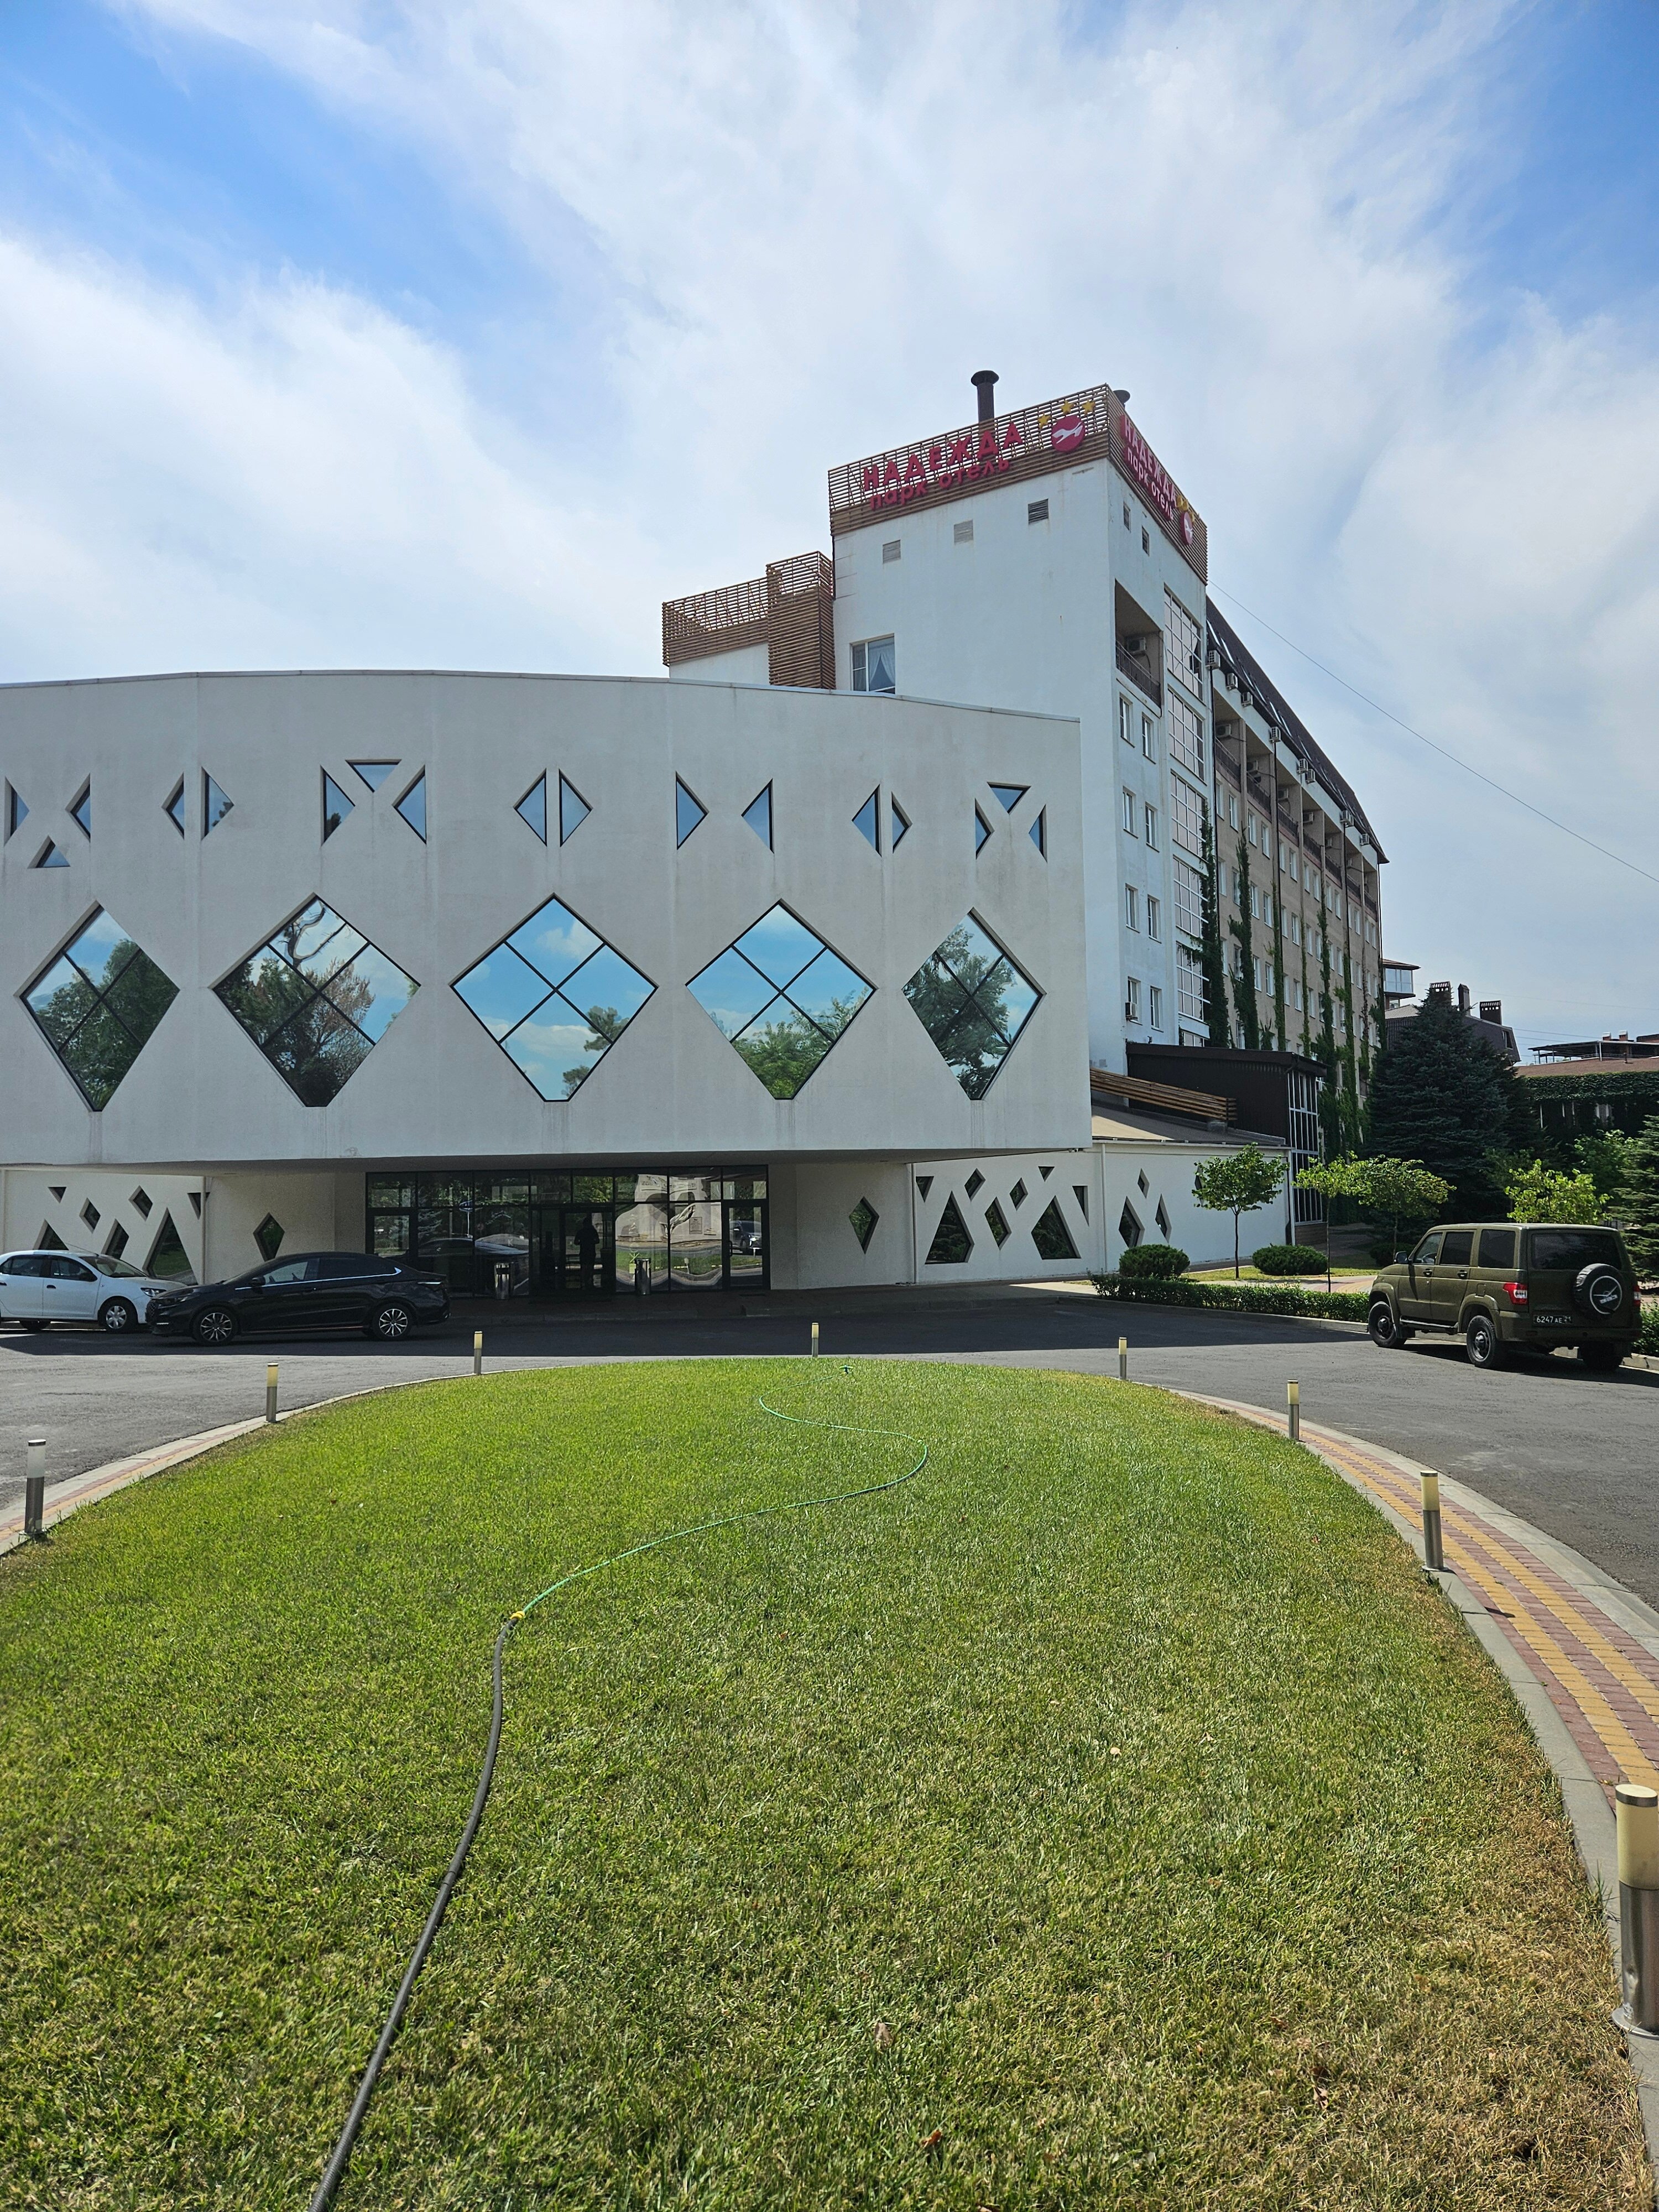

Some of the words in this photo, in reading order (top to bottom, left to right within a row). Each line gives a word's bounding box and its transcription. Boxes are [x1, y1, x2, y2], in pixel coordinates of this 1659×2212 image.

[863, 421, 1024, 492] НАДЕЖДА
[870, 481, 927, 510] парк
[939, 457, 1010, 489] отель
[1124, 415, 1177, 508] НАДЕЖДА
[1128, 446, 1149, 487] парк
[1151, 481, 1173, 520] отель
